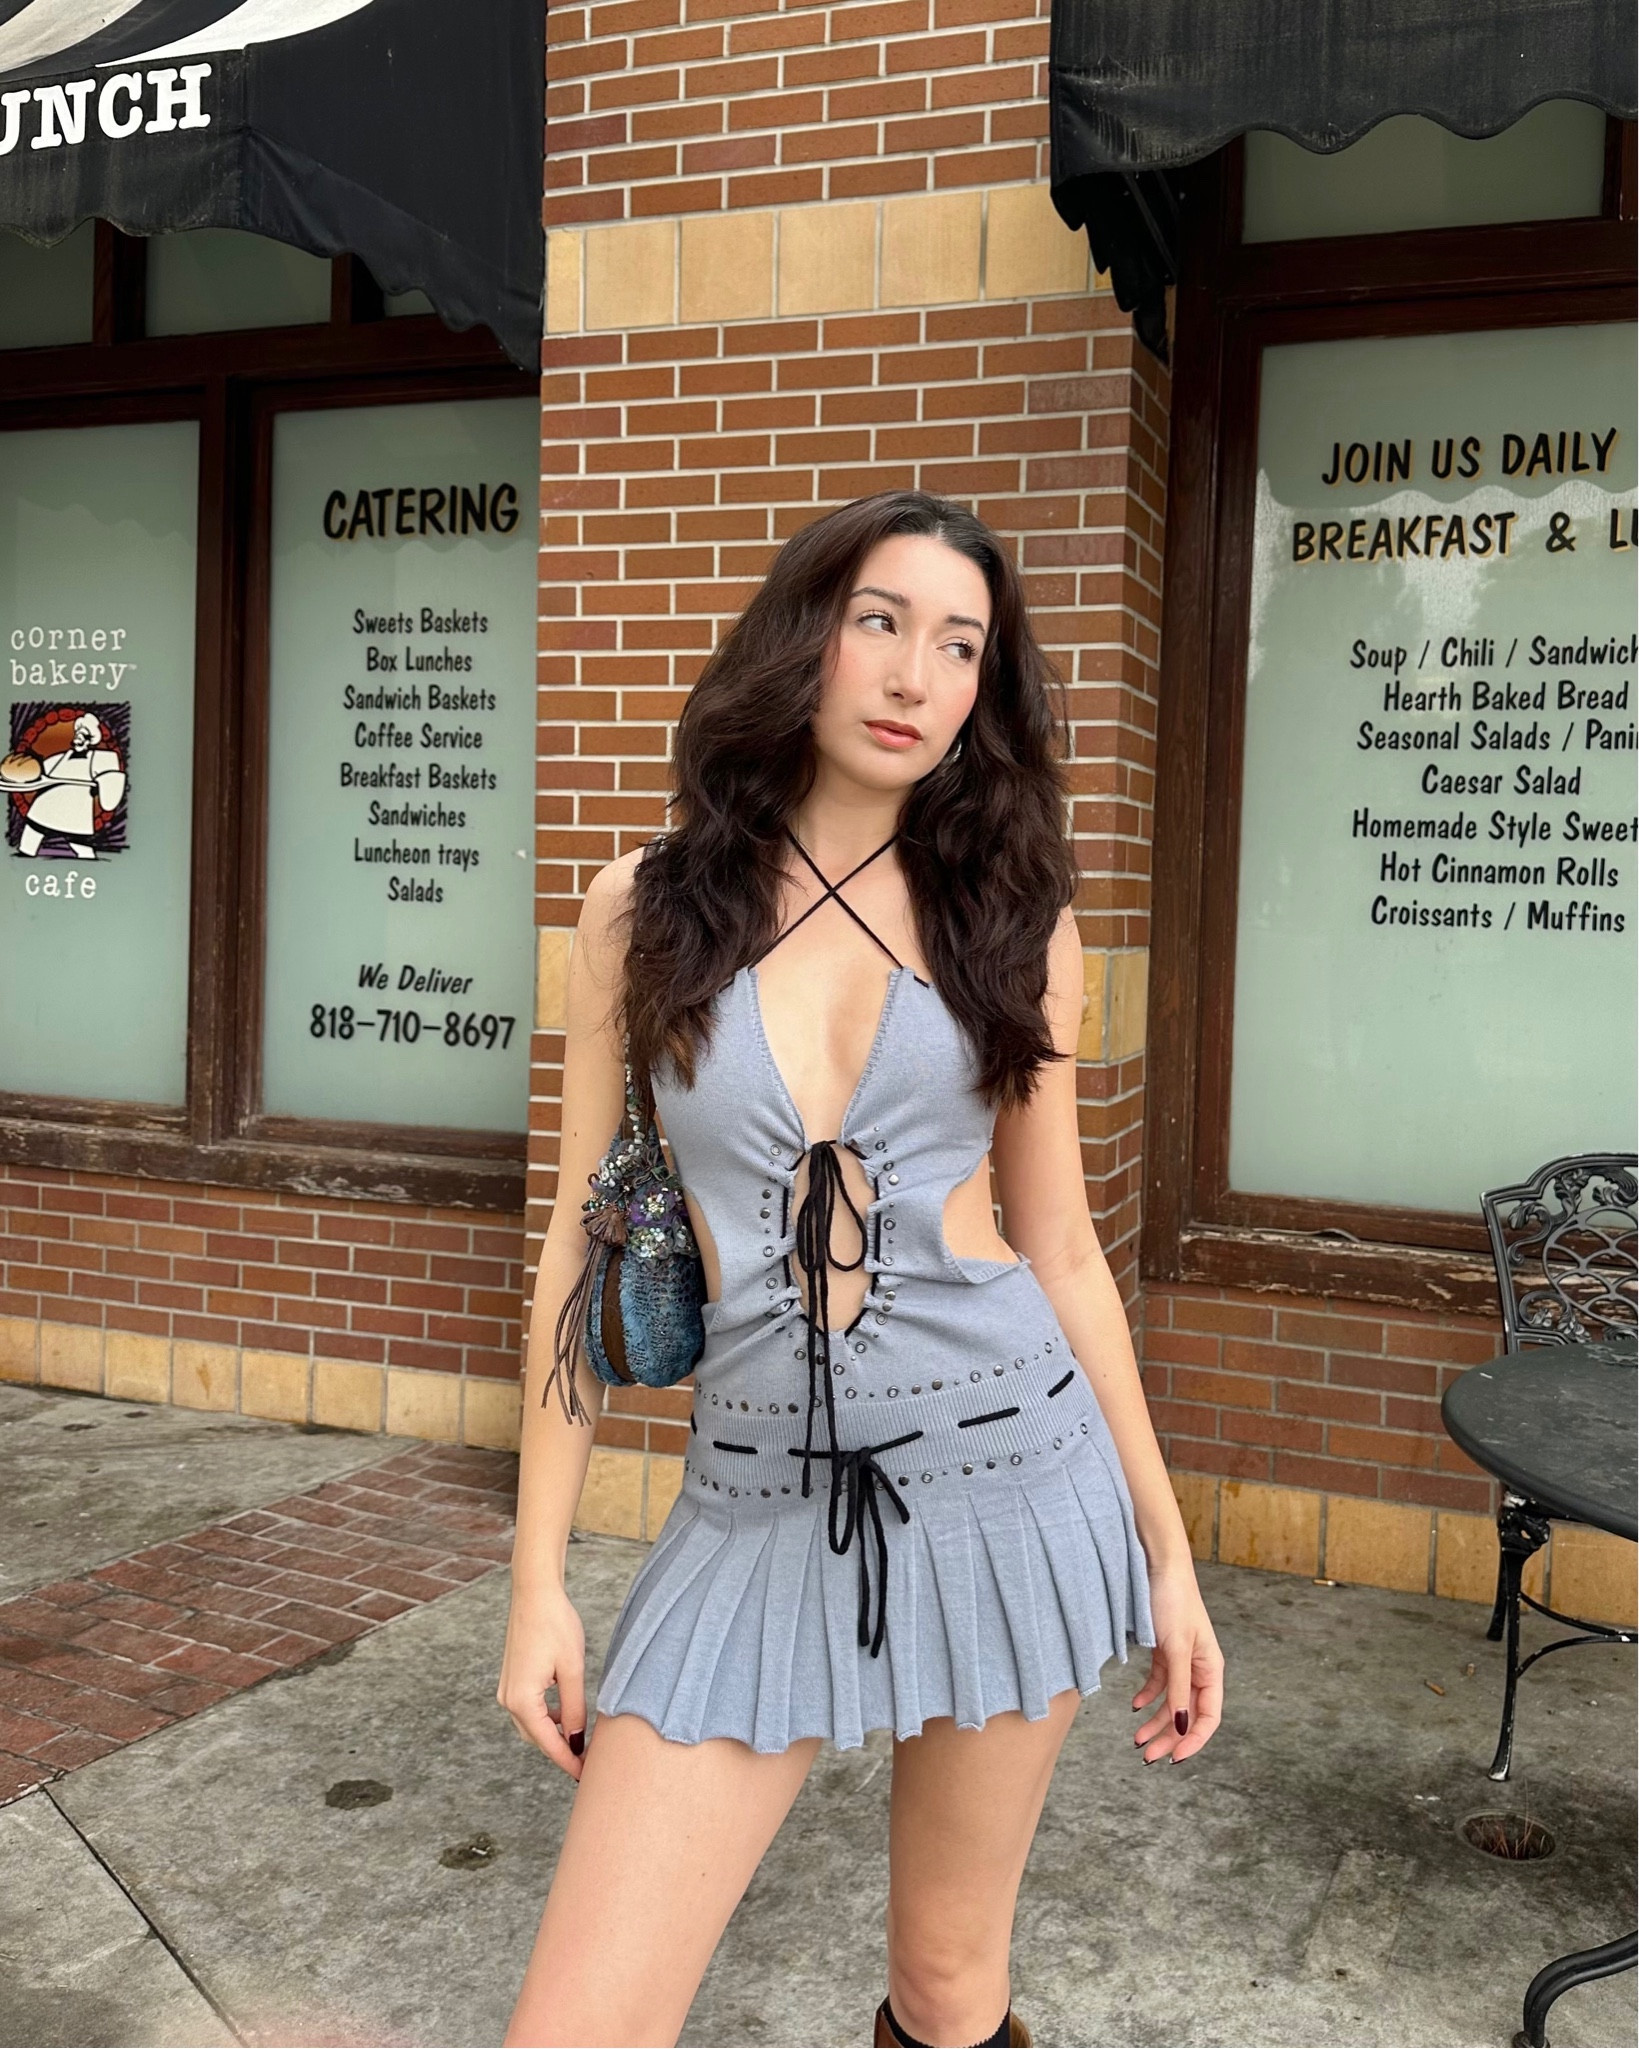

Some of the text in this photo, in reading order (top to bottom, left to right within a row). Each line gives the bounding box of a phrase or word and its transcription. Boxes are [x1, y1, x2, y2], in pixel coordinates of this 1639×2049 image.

[1321, 427, 1617, 485] JOIN US DAILY
[323, 482, 519, 540] CATERING
[1292, 511, 1516, 562] BREAKFAST
[1545, 511, 1576, 553] &
[352, 607, 488, 634] Sweets Baskets
[11, 626, 126, 651] corner
[367, 646, 472, 672] Box Lunches
[1349, 639, 1407, 676] Soup
[1417, 639, 1430, 670] /
[1441, 636, 1495, 668] Chili
[1505, 638, 1518, 668] /
[9, 659, 127, 691] bakery
[343, 684, 496, 711] Sandwich Baskets
[1383, 679, 1629, 712] Hearth Baked Bread
[354, 721, 483, 749] Coffee Service
[1356, 718, 1637, 752] Seasonal Salads / Pani
[340, 762, 497, 790] Breakfast Baskets
[1421, 763, 1582, 796] Caesar Salad
[368, 800, 466, 828] Sandwiches
[1352, 807, 1637, 849] Homemade Style Sweet
[354, 837, 480, 872] Luncheon trays
[1380, 850, 1619, 887] Hot Cinnamon Rolls
[25, 870, 97, 899] cafe
[387, 876, 443, 903] Salads
[1371, 895, 1625, 933] Croissants / Muffins
[358, 963, 474, 994] We Deliver
[310, 1003, 516, 1050] 818-710-8697
